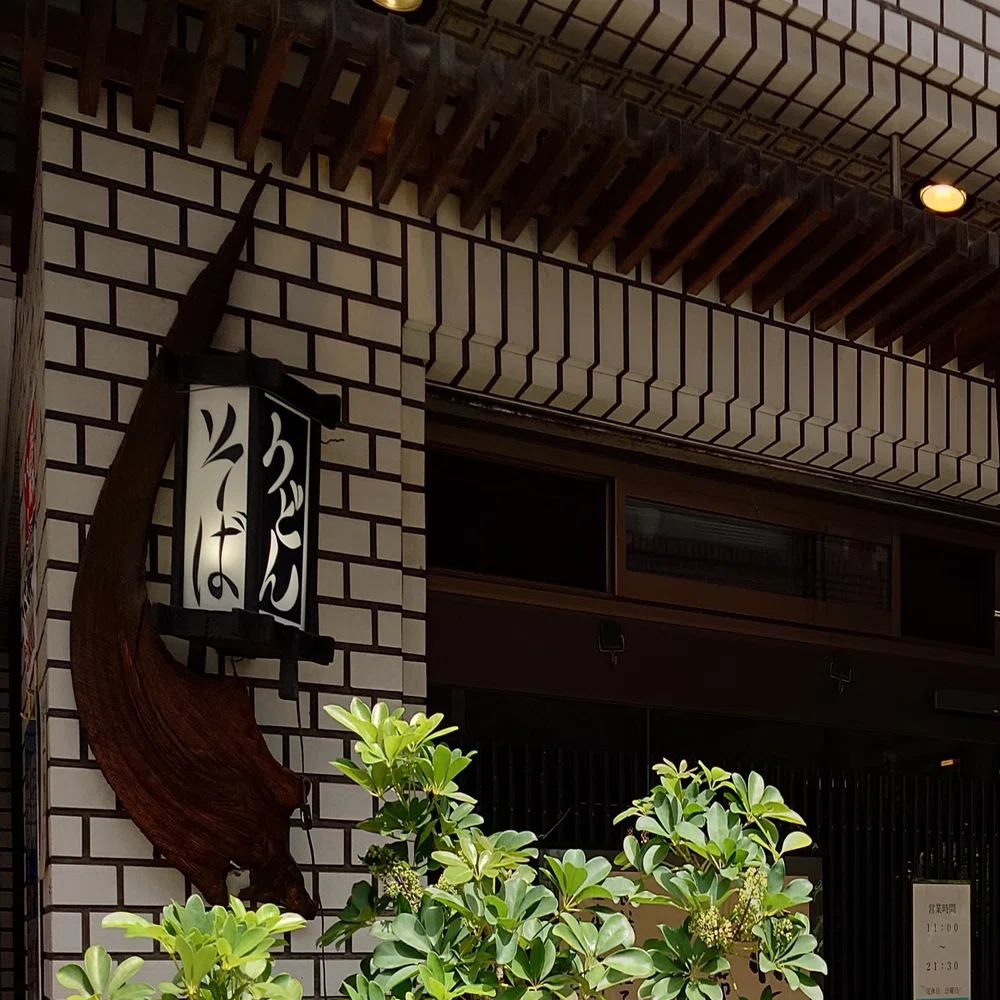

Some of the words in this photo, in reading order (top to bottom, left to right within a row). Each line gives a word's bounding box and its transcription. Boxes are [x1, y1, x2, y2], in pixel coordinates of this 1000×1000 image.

[192, 402, 248, 607] そば
[258, 411, 304, 612] うどん
[928, 903, 957, 914] 営業時間
[926, 923, 959, 933] 11:00
[926, 961, 959, 971] 21:30
